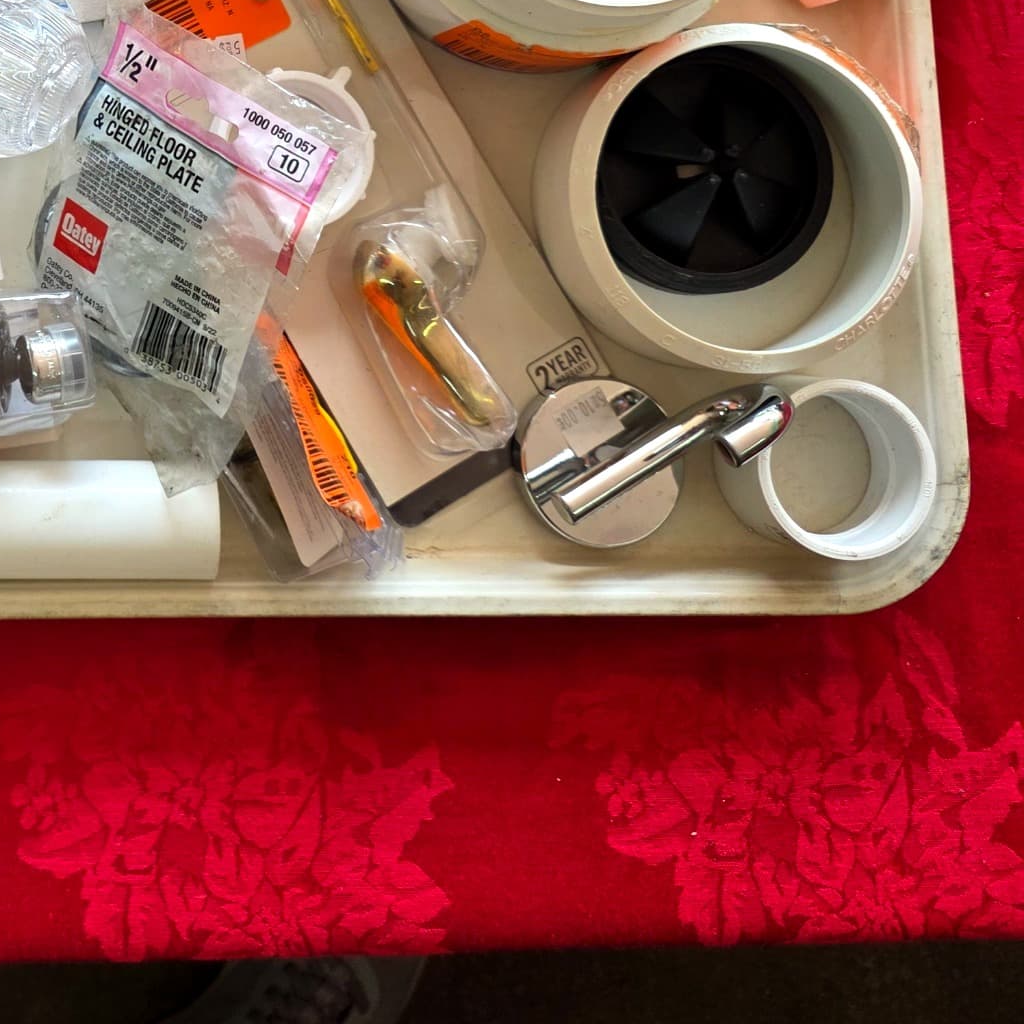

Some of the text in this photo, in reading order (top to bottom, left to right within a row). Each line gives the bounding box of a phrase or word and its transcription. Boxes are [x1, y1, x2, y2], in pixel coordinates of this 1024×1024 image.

[91, 113, 106, 129] &
[101, 120, 160, 163] CEILING
[153, 154, 206, 193] PLATE
[98, 94, 153, 135] HINGED
[146, 127, 199, 167] FLOOR
[243, 106, 317, 156] 1000 050 057
[278, 153, 299, 175] 10
[60, 212, 102, 257] Oatey
[168, 280, 222, 315] HECHO EN CHINA
[172, 274, 223, 306] MADE IN CHINA
[533, 342, 589, 394] 2 YEAR
